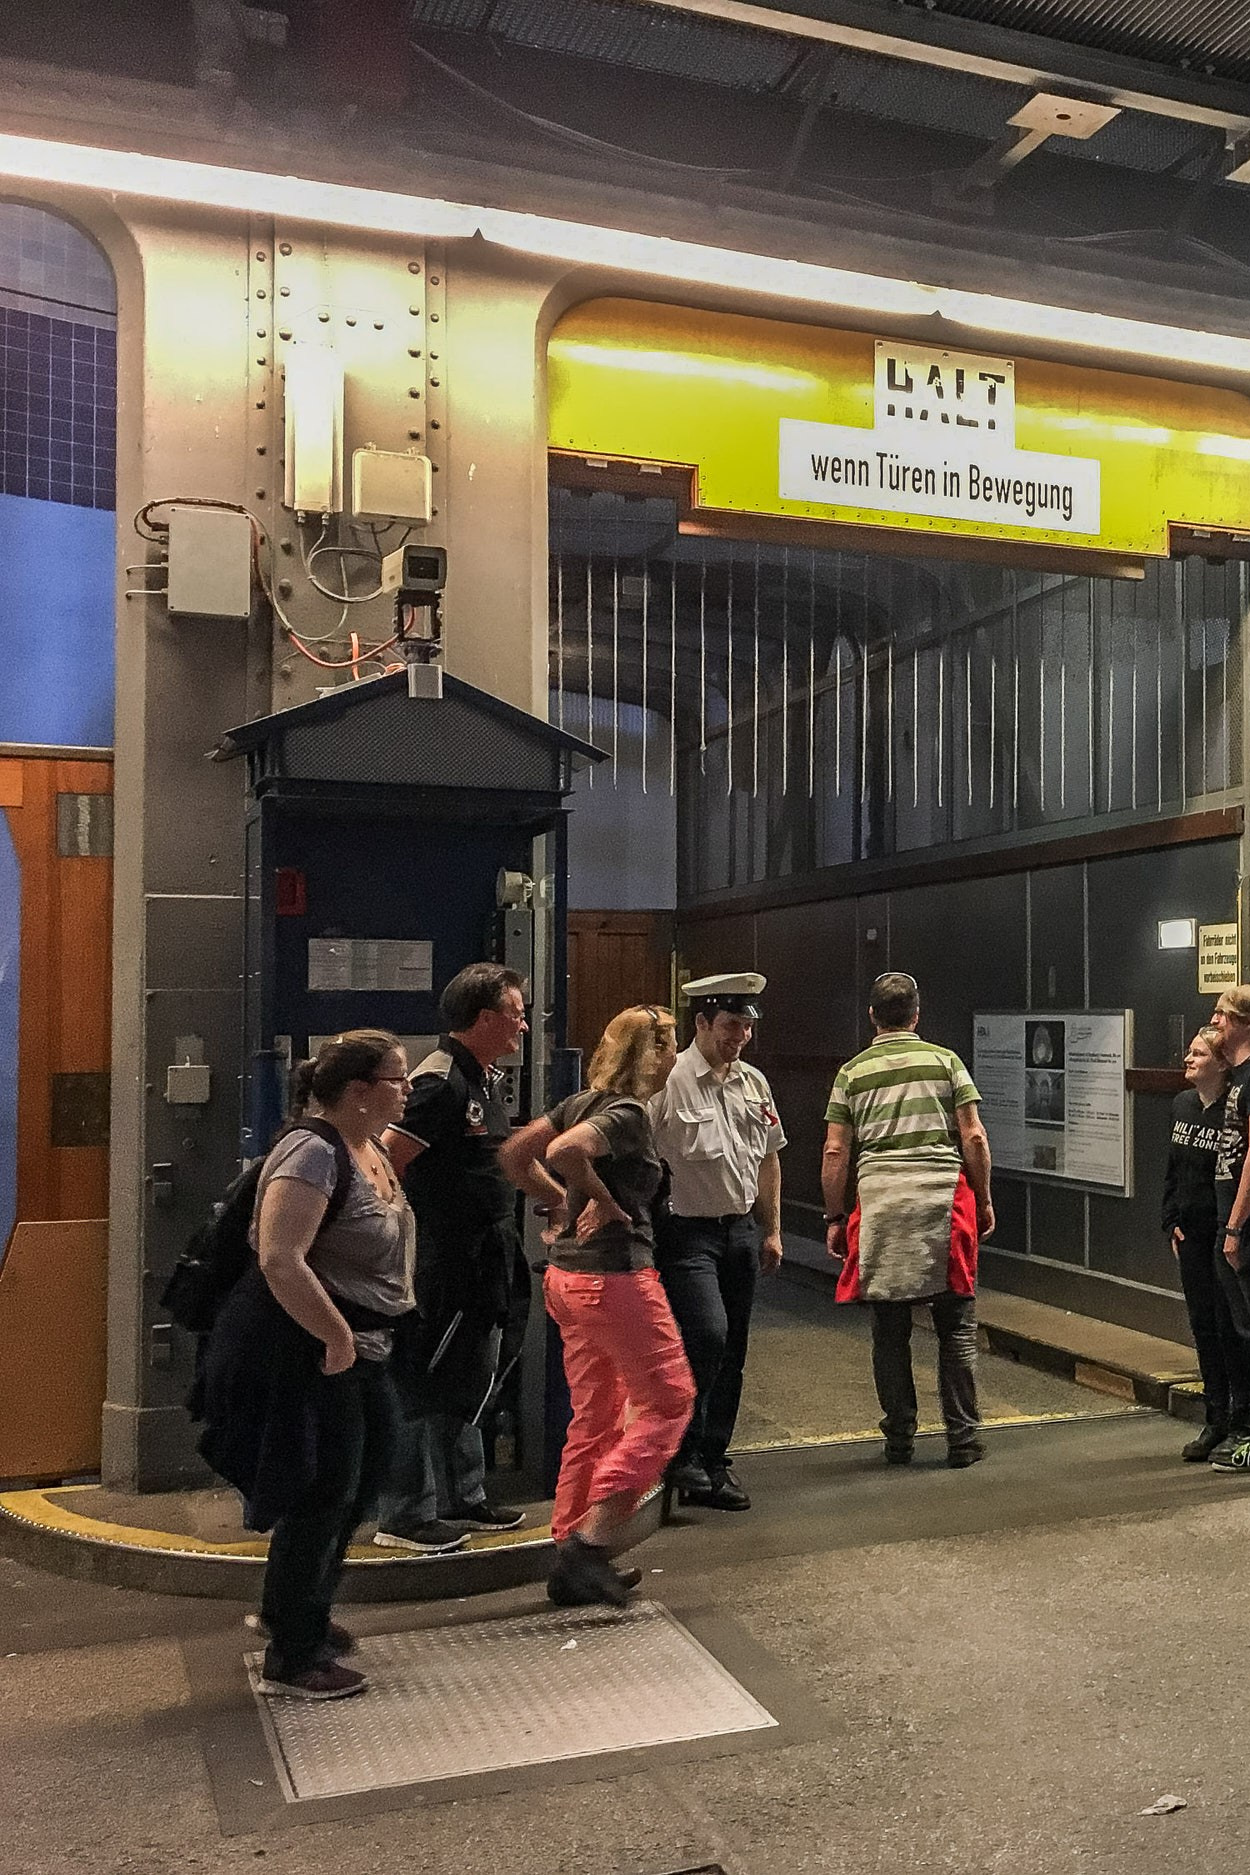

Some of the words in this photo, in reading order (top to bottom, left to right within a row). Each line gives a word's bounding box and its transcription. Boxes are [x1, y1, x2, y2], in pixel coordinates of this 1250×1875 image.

[811, 453, 869, 486] wenn
[876, 452, 935, 495] Türen
[943, 461, 960, 498] in
[969, 463, 1073, 521] Bewegung
[1173, 1120, 1222, 1141] MILIARY
[1171, 1132, 1189, 1145] FREE
[1192, 1137, 1219, 1151] ZONE
